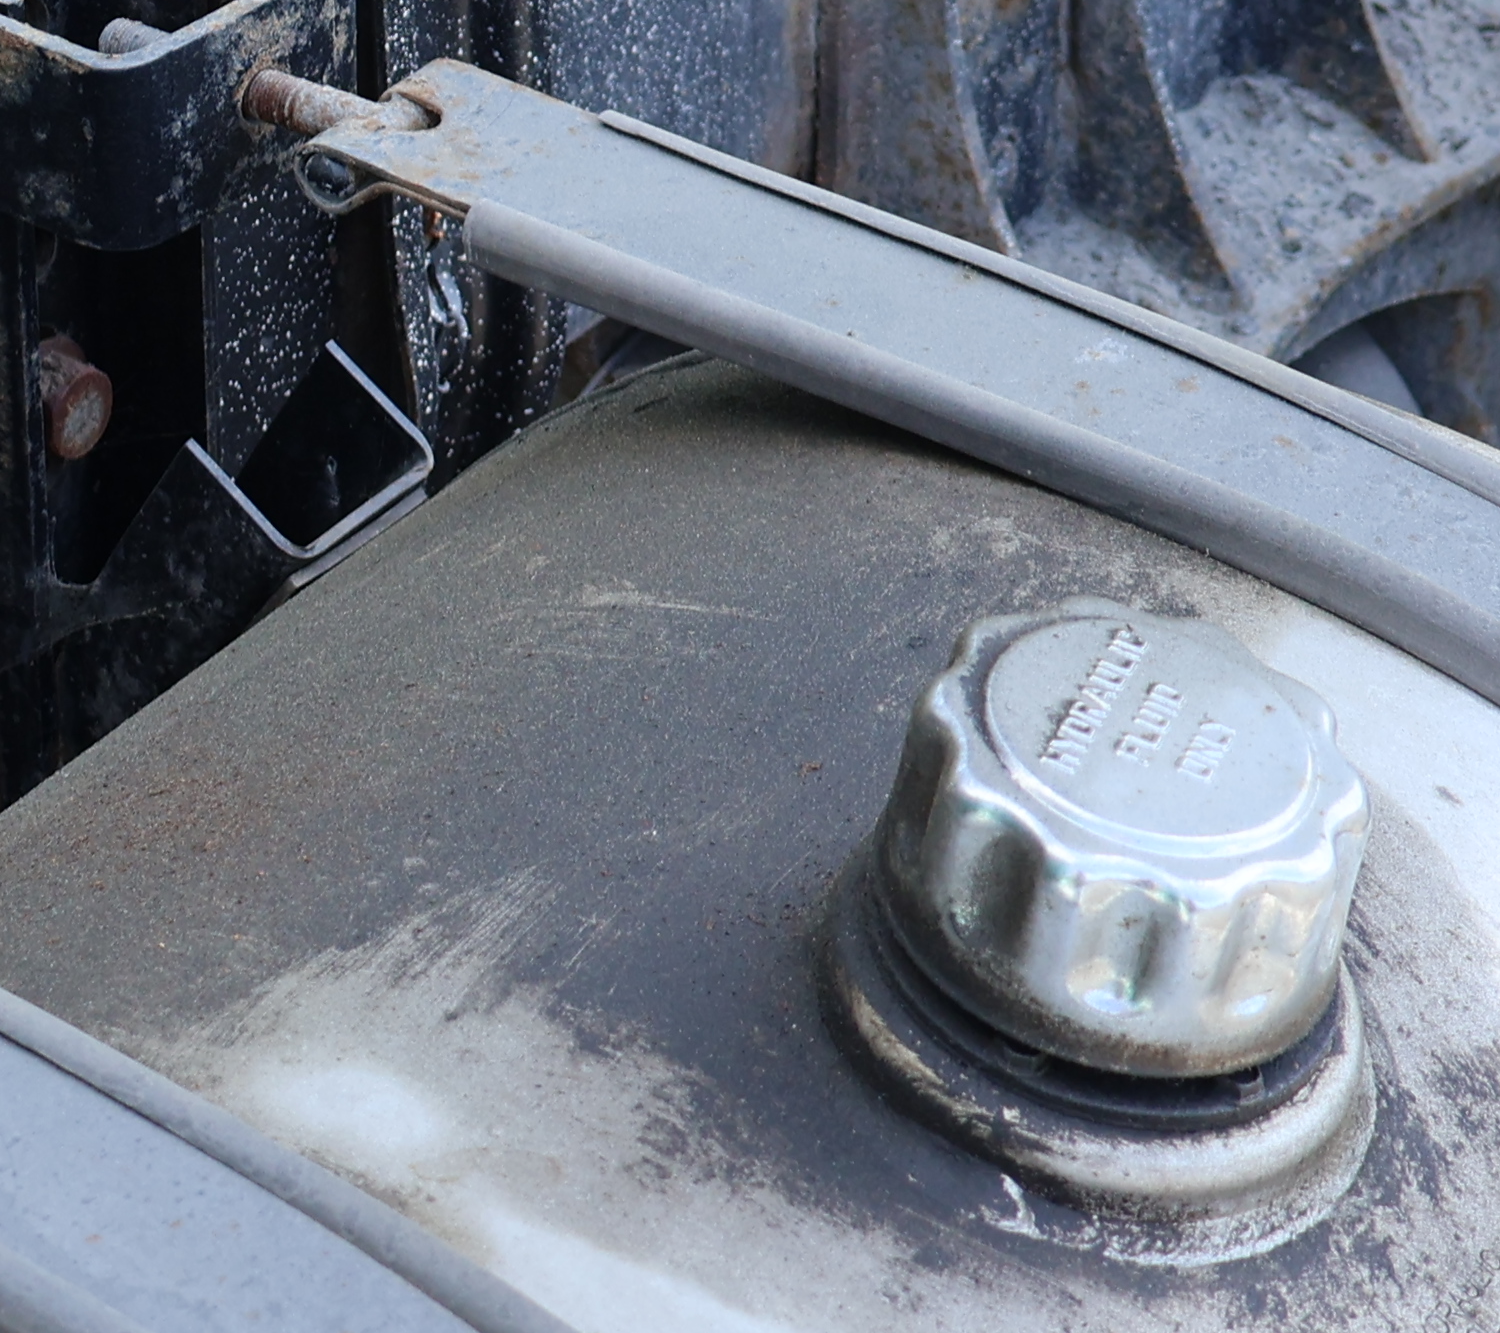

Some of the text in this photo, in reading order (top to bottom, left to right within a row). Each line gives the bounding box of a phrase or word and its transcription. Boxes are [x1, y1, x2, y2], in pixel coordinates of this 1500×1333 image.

[1039, 630, 1149, 775] HYDRAULIC
[1116, 684, 1187, 768] FLUID
[1177, 723, 1236, 783] ONLY
